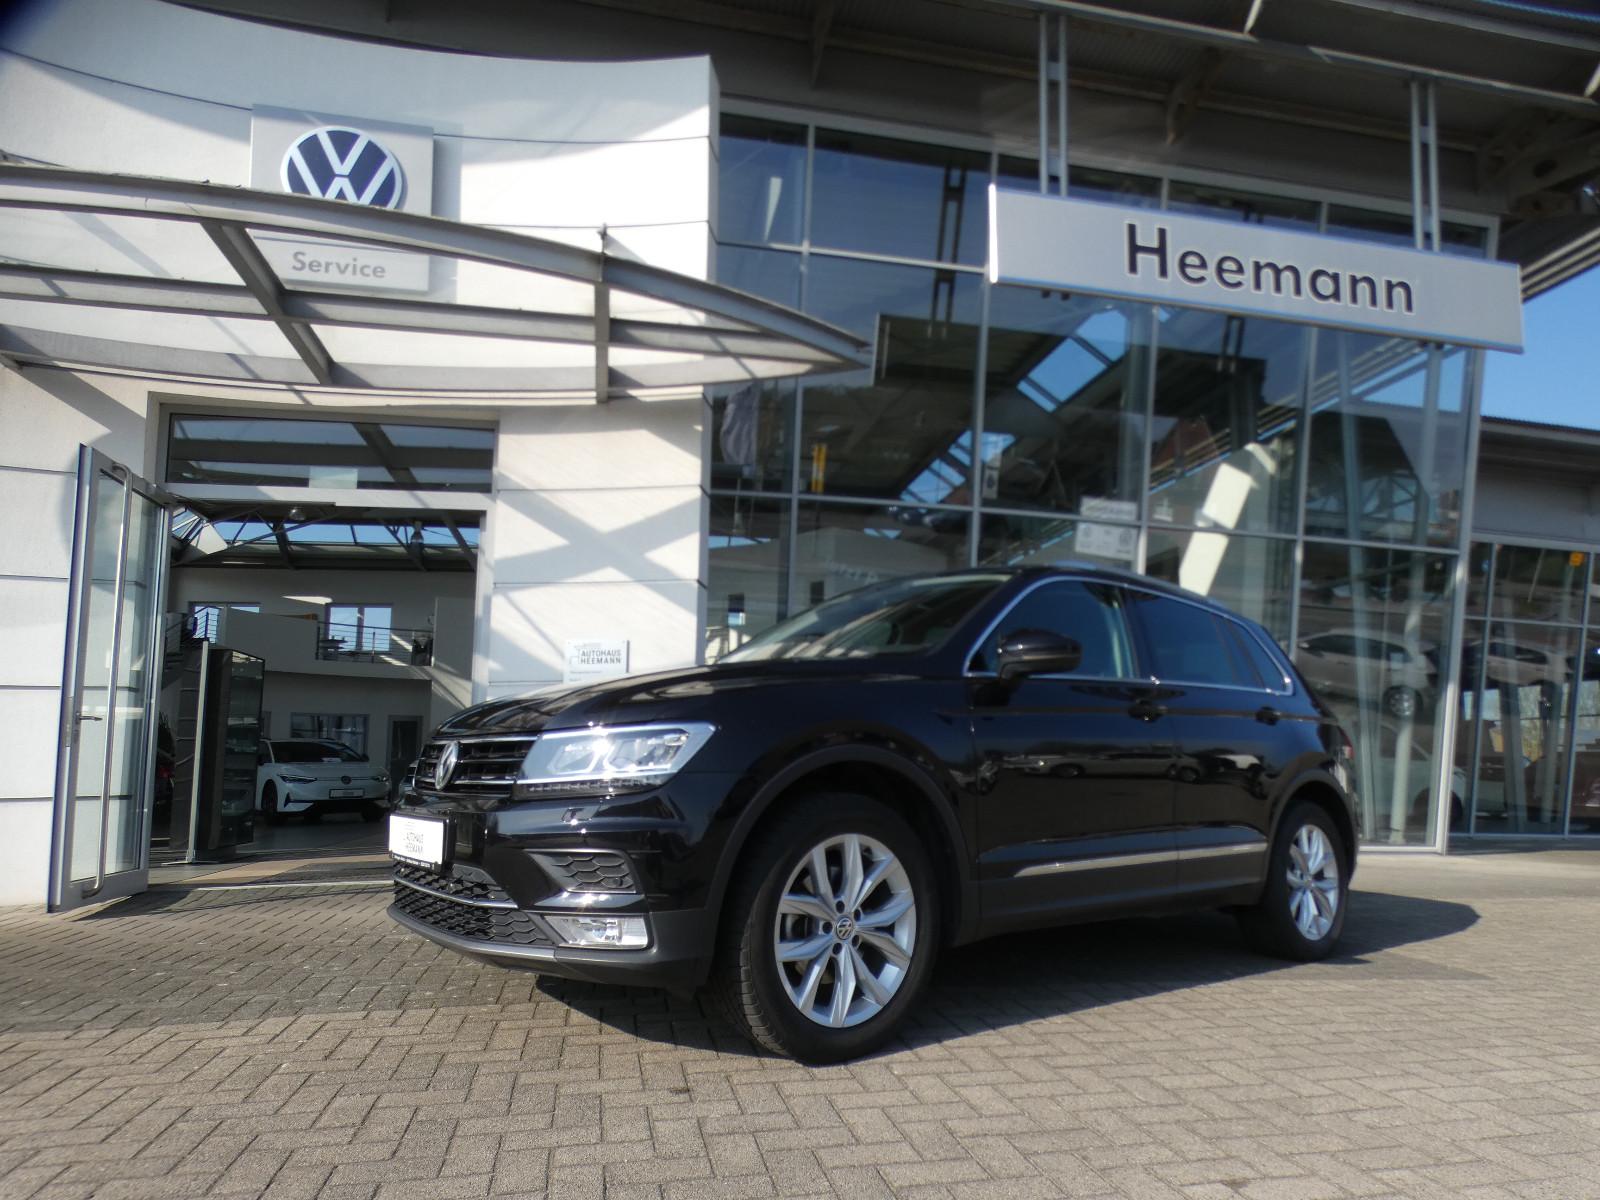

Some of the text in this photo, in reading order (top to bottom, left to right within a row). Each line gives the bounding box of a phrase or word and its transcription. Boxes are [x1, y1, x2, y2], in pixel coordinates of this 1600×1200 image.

[292, 251, 386, 279] Service
[1126, 222, 1414, 313] Heemann
[581, 649, 622, 657] AUTOHAUS
